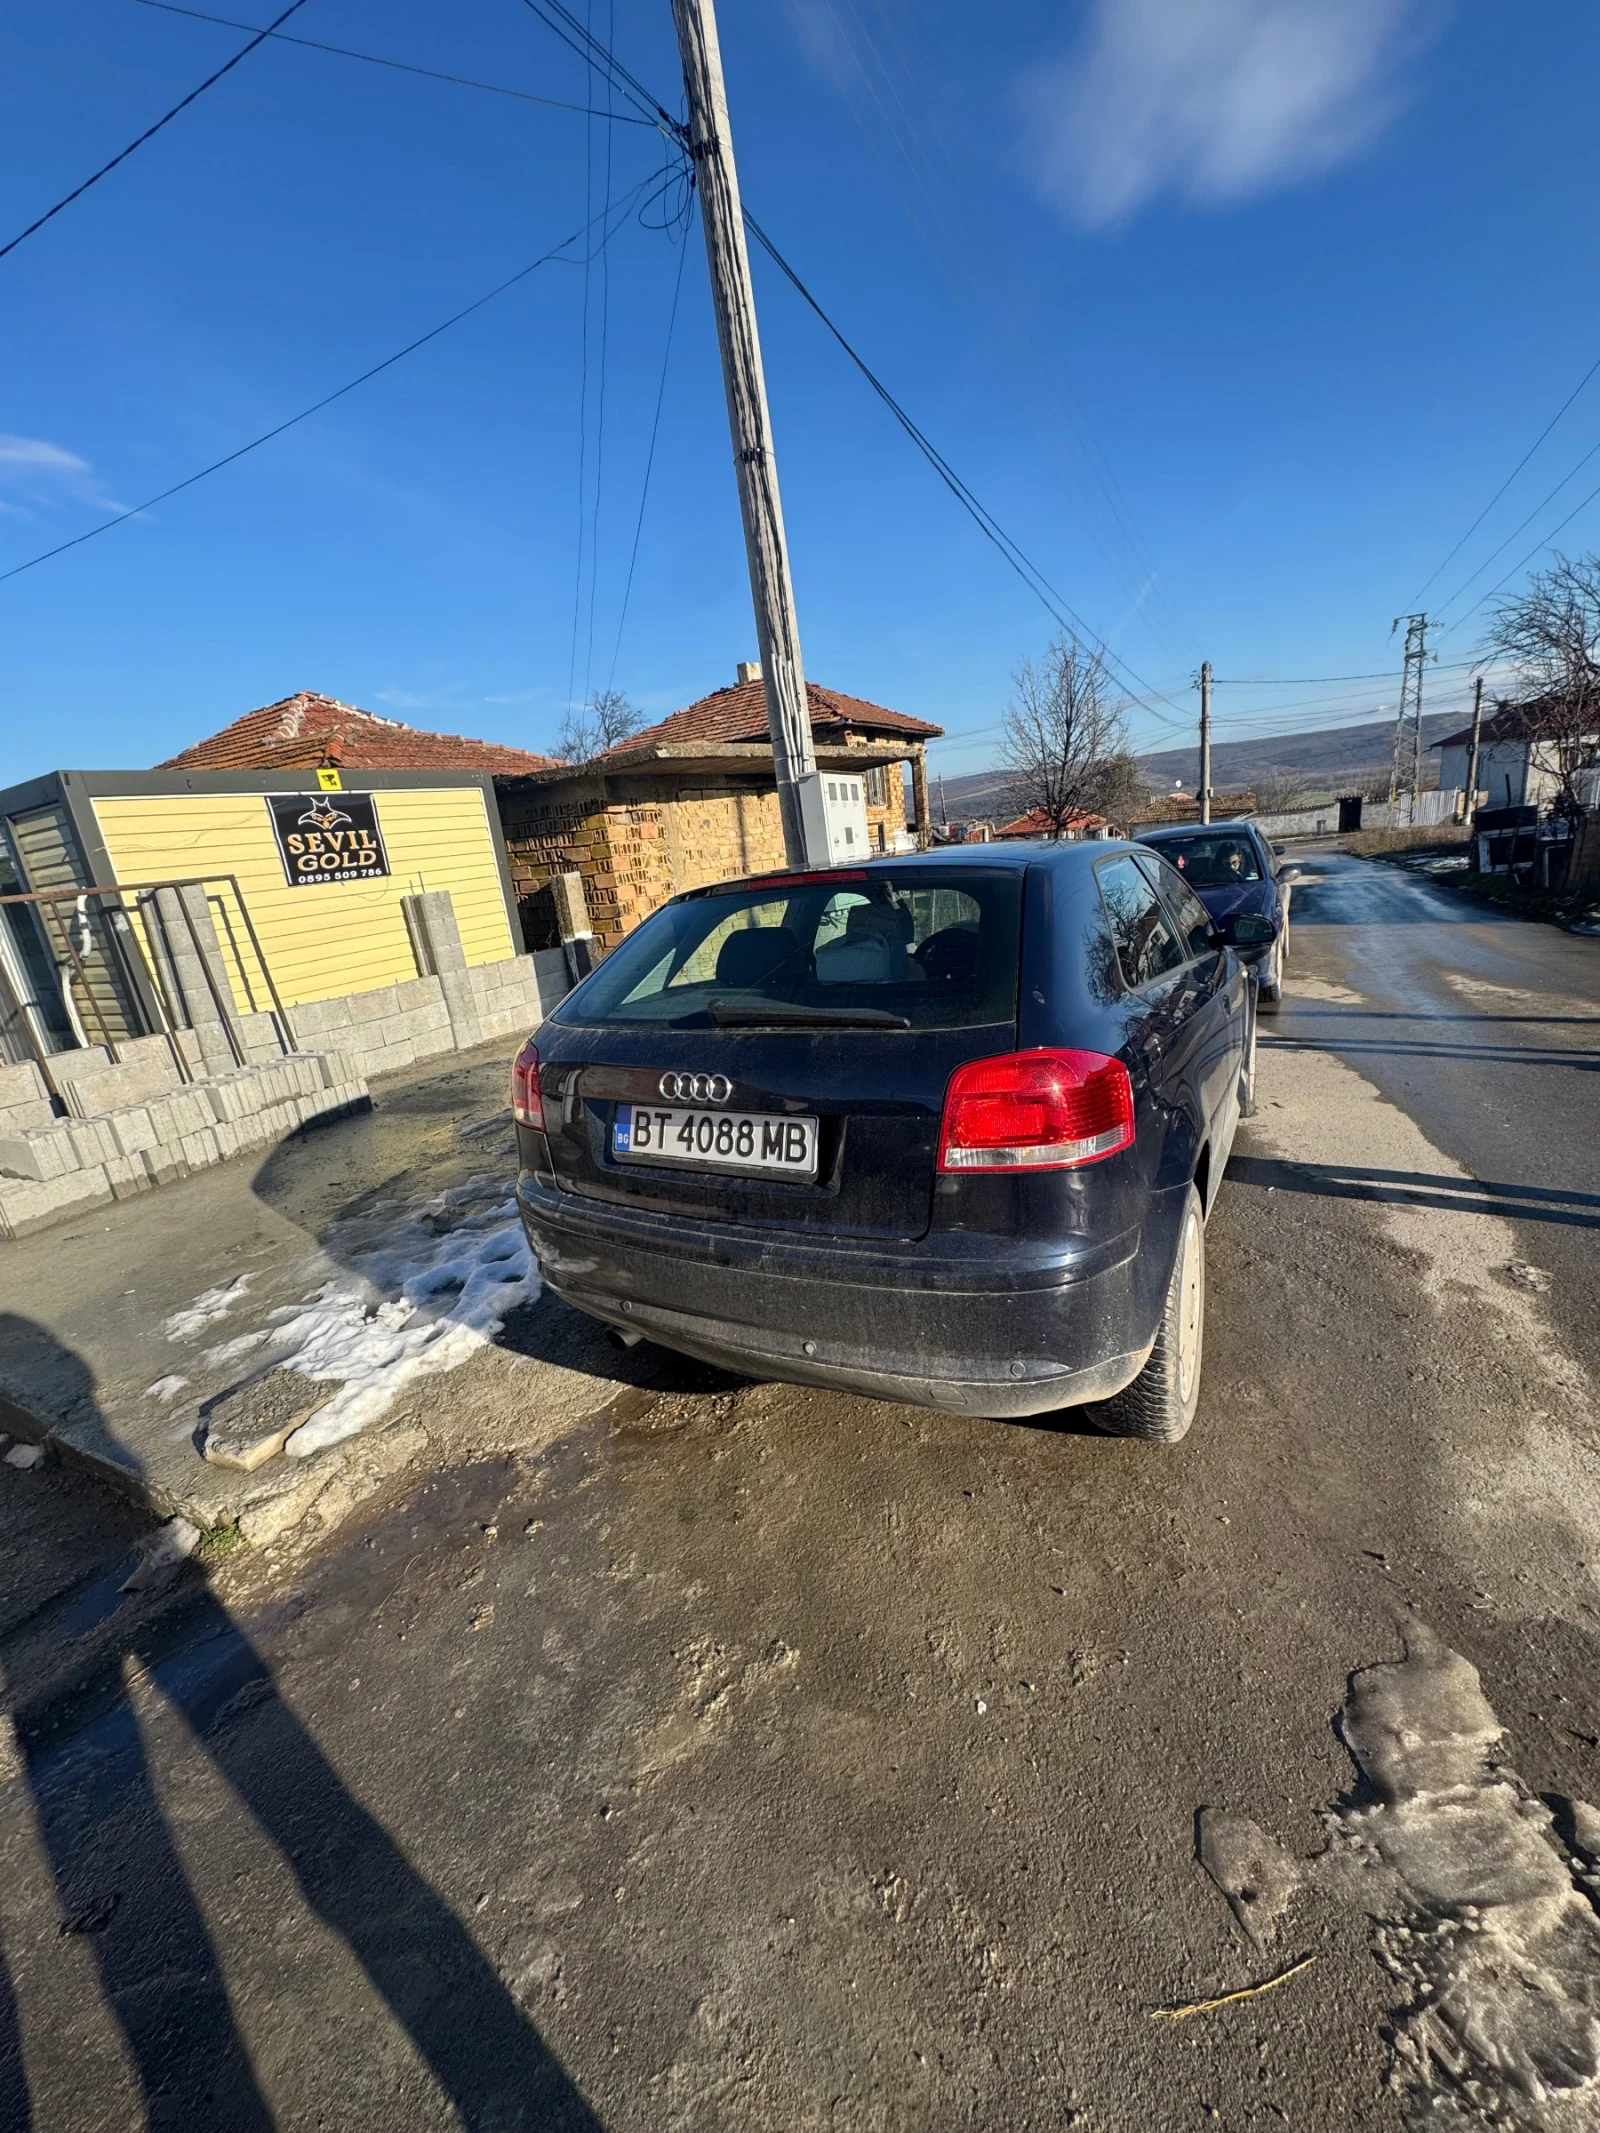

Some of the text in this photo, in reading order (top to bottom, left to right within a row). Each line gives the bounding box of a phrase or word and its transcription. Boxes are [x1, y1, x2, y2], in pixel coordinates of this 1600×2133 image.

[287, 830, 377, 854] SEVIL
[297, 850, 377, 871] GOLD
[298, 868, 382, 883] 0895 509 786
[617, 1133, 629, 1145] BG
[633, 1111, 808, 1163] BT 4088 MB
